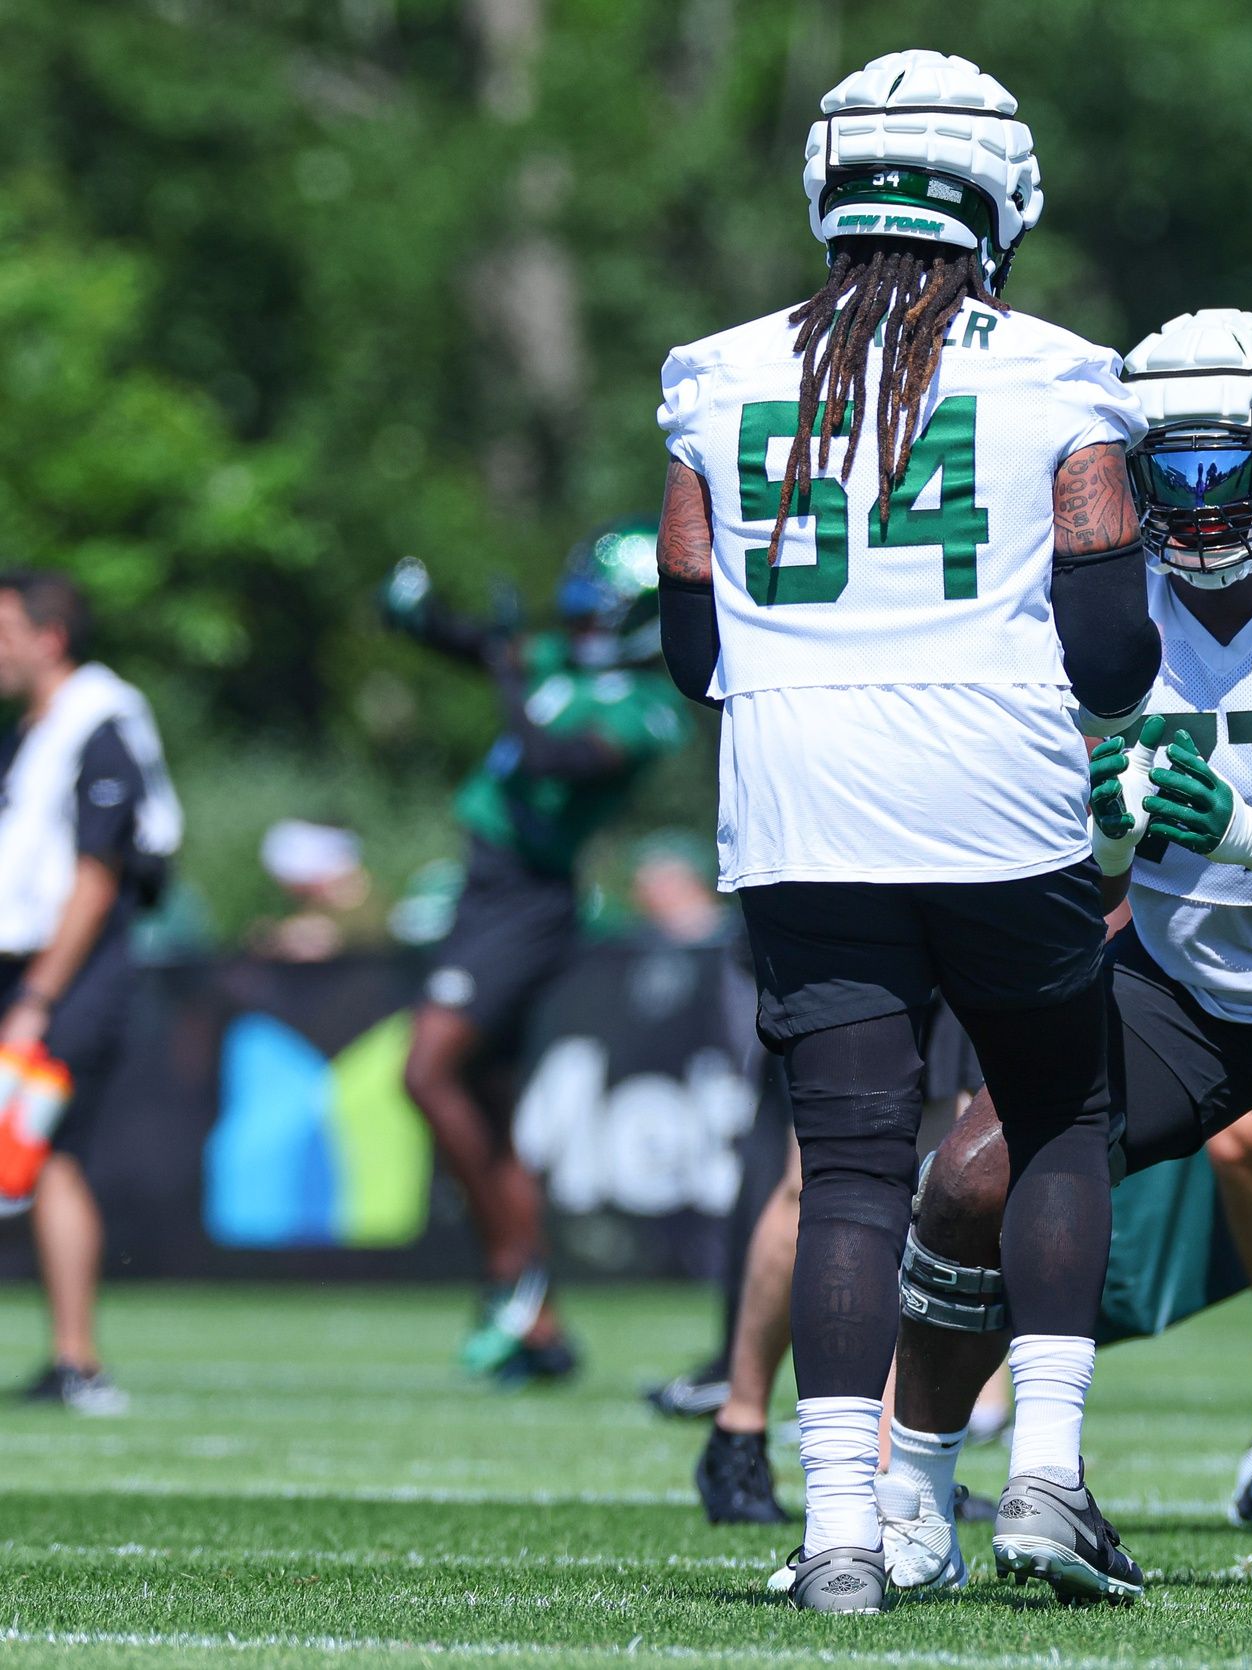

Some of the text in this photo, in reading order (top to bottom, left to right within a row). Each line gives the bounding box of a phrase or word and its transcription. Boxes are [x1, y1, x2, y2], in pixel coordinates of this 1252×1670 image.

[837, 214, 945, 236] NEW YORK
[737, 395, 989, 607] 54
